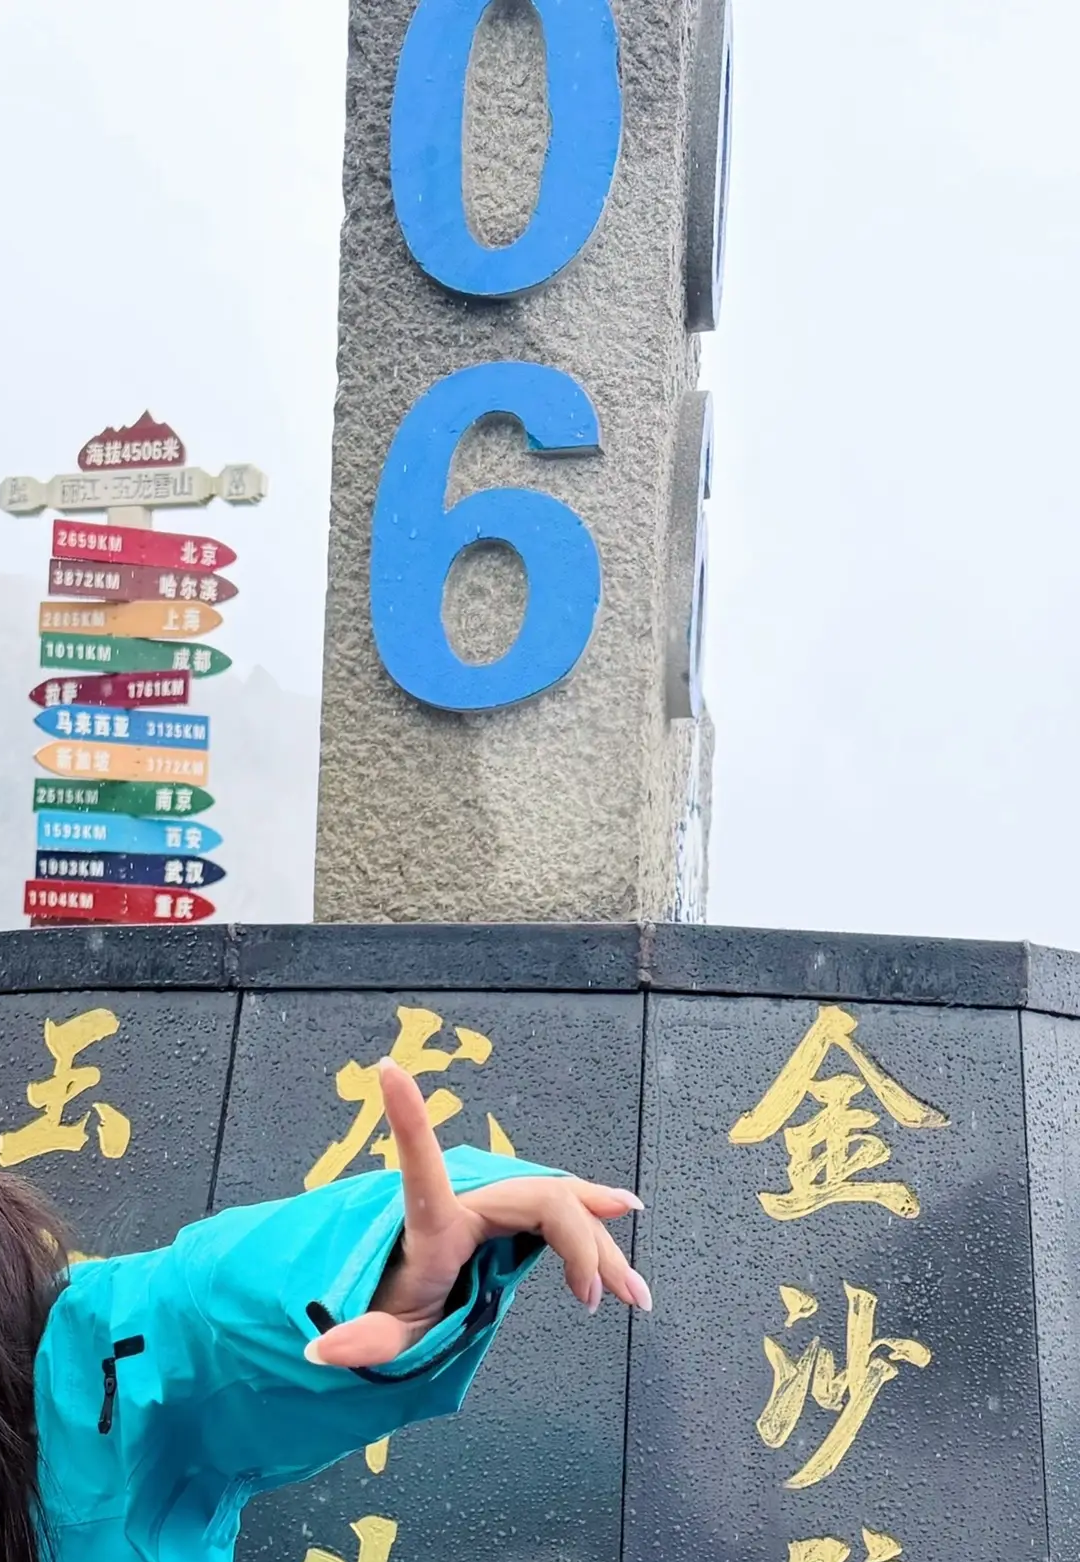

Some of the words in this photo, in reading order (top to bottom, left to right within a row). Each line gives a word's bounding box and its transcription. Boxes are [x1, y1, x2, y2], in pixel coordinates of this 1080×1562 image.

[85, 437, 180, 466] 海拔4506米
[180, 540, 218, 566] 北京
[159, 573, 218, 602] 哈尔滨
[162, 607, 200, 632] 上海
[45, 642, 112, 662] 1011KM
[172, 647, 212, 673] 成都
[56, 711, 130, 737] 马来西亚
[56, 748, 110, 772] 新加坡
[155, 788, 193, 811] 南京
[166, 825, 202, 849] 西安
[164, 860, 204, 884] 武汉
[154, 893, 194, 918] 重庆
